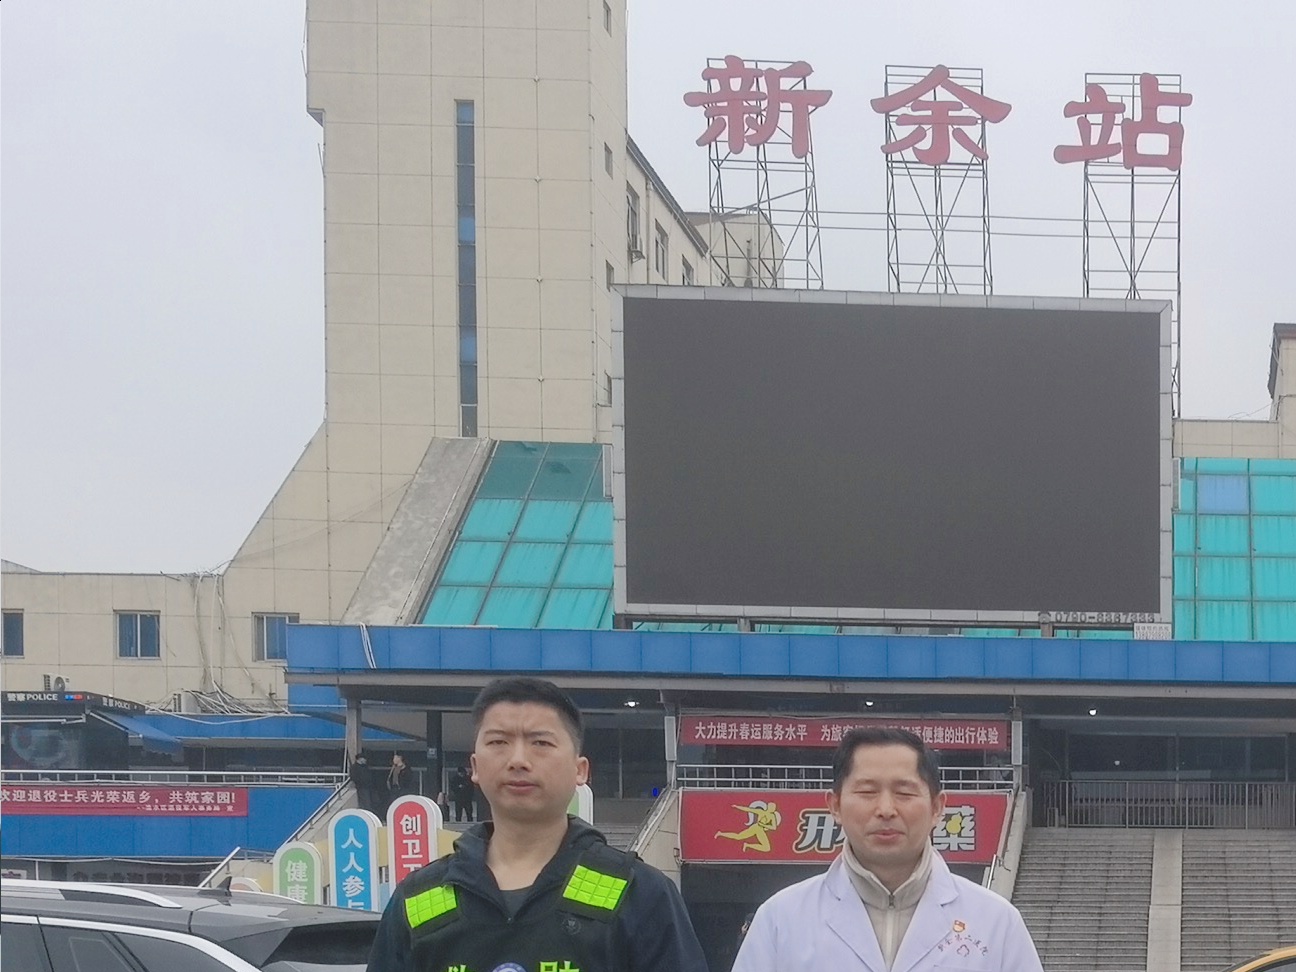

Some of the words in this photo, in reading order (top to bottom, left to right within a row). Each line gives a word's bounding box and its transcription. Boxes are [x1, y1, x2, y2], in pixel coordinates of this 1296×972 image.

[684, 55, 1193, 170] 新余站
[26, 693, 58, 701] POLICE
[694, 721, 808, 742] 大力提升春运服务水平
